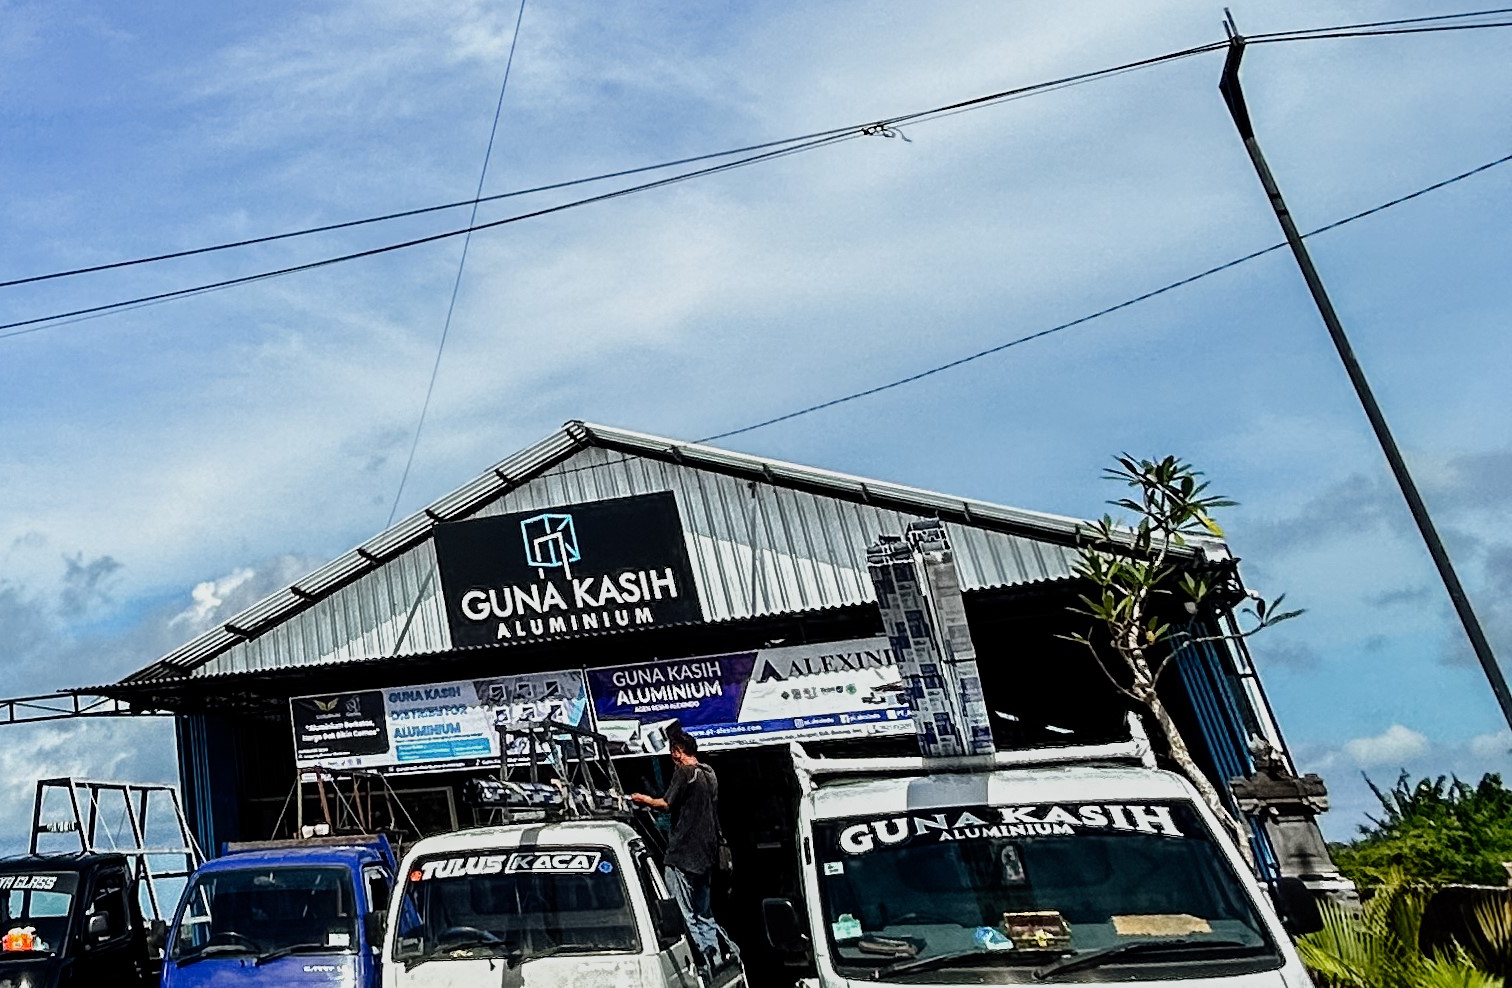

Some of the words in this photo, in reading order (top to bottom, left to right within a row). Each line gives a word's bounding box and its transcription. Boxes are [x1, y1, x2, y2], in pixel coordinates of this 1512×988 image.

[461, 581, 567, 621] GUNA
[570, 567, 678, 609] KASIH
[496, 607, 654, 639] ALUMINIUM
[612, 667, 665, 687] GUNA
[667, 661, 722, 681] KASIH
[388, 690, 424, 703] GUNA
[424, 686, 461, 700] KASIH
[616, 680, 723, 706] ALUMINIUM
[393, 722, 462, 738] ALUMINIUM
[839, 812, 989, 854] GUNA
[999, 805, 1185, 837] KASIH
[938, 822, 1076, 841] ALUMINIUM
[422, 855, 507, 880] TULUS
[511, 855, 590, 869] KACA
[13, 876, 57, 889] GLASS
